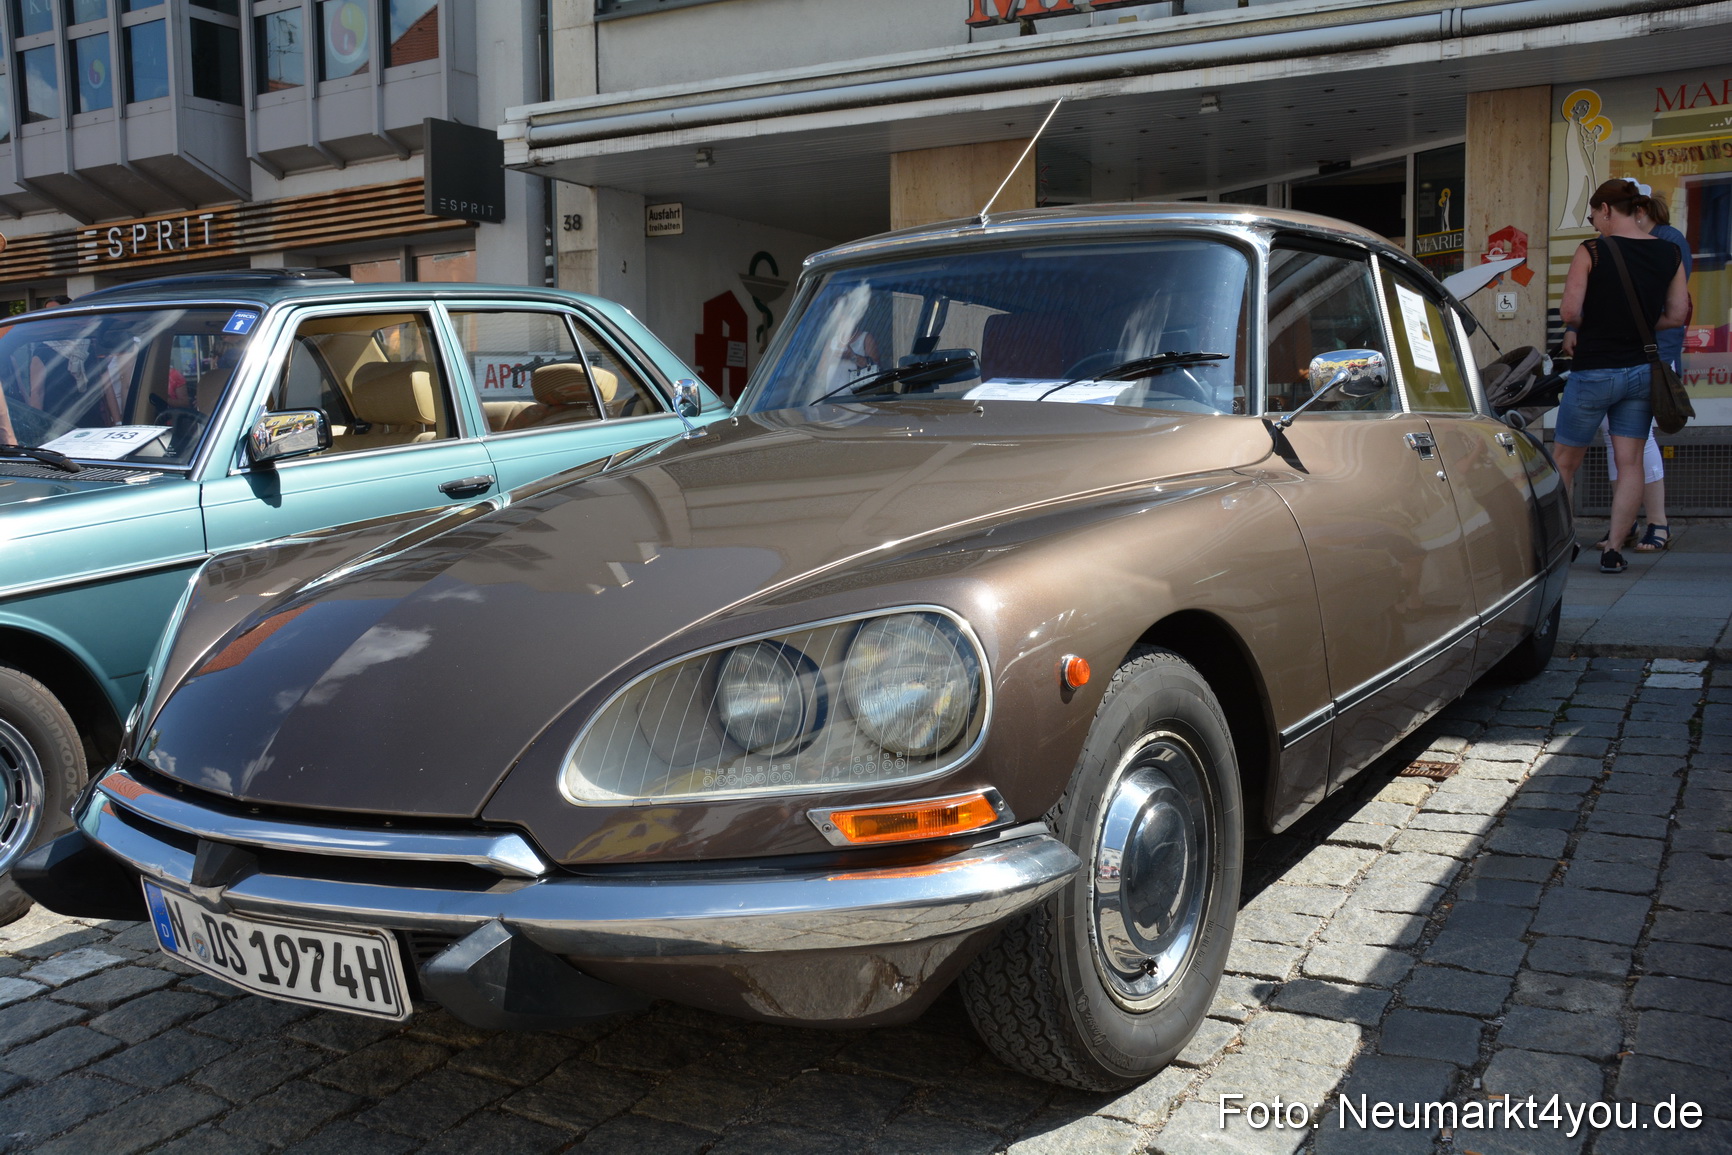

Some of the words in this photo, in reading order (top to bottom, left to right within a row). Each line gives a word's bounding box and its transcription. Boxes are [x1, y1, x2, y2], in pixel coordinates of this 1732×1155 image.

[440, 197, 494, 216] ESPRIT
[648, 207, 681, 221] Ausfahrt
[563, 213, 583, 232] 38
[84, 213, 214, 258] ESPRIT
[1416, 232, 1464, 254] MARIE
[102, 430, 139, 441] 153
[160, 923, 169, 938] D
[164, 896, 192, 952] N
